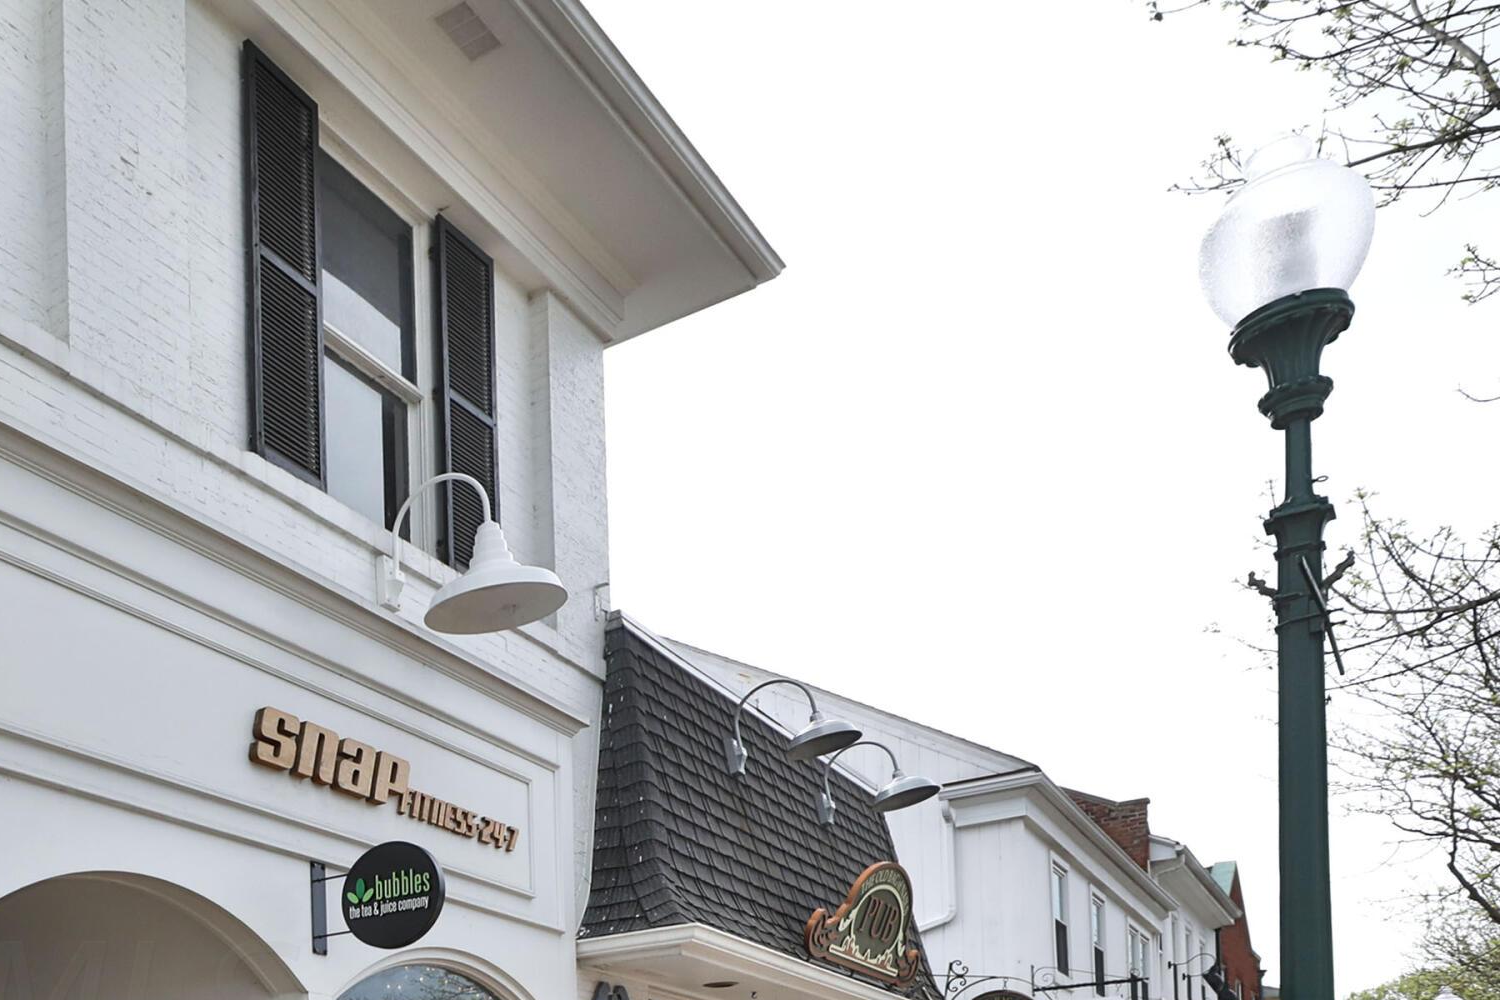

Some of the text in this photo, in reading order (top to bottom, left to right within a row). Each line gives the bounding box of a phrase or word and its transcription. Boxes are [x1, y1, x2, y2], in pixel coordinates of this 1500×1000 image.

[374, 868, 431, 900] bubbles
[349, 895, 429, 919] the tea & juice company
[859, 896, 899, 944] PUB
